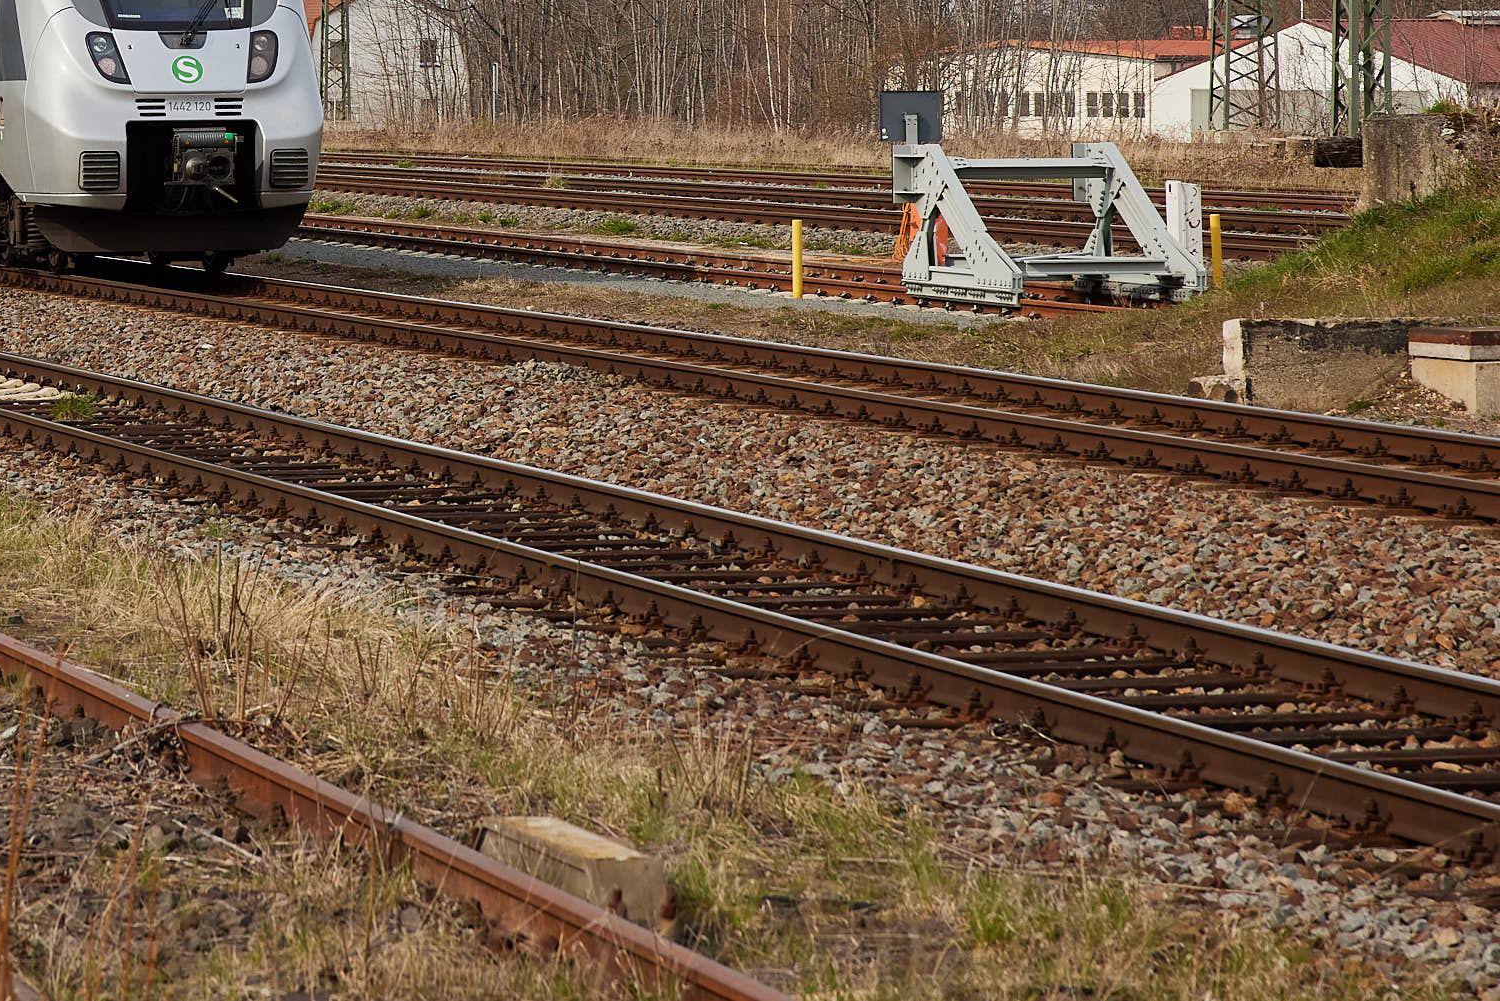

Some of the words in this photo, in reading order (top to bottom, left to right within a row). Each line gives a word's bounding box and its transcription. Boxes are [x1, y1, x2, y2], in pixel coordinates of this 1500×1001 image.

[175, 58, 200, 82] S
[168, 101, 192, 112] 1442
[194, 101, 211, 111] 120
